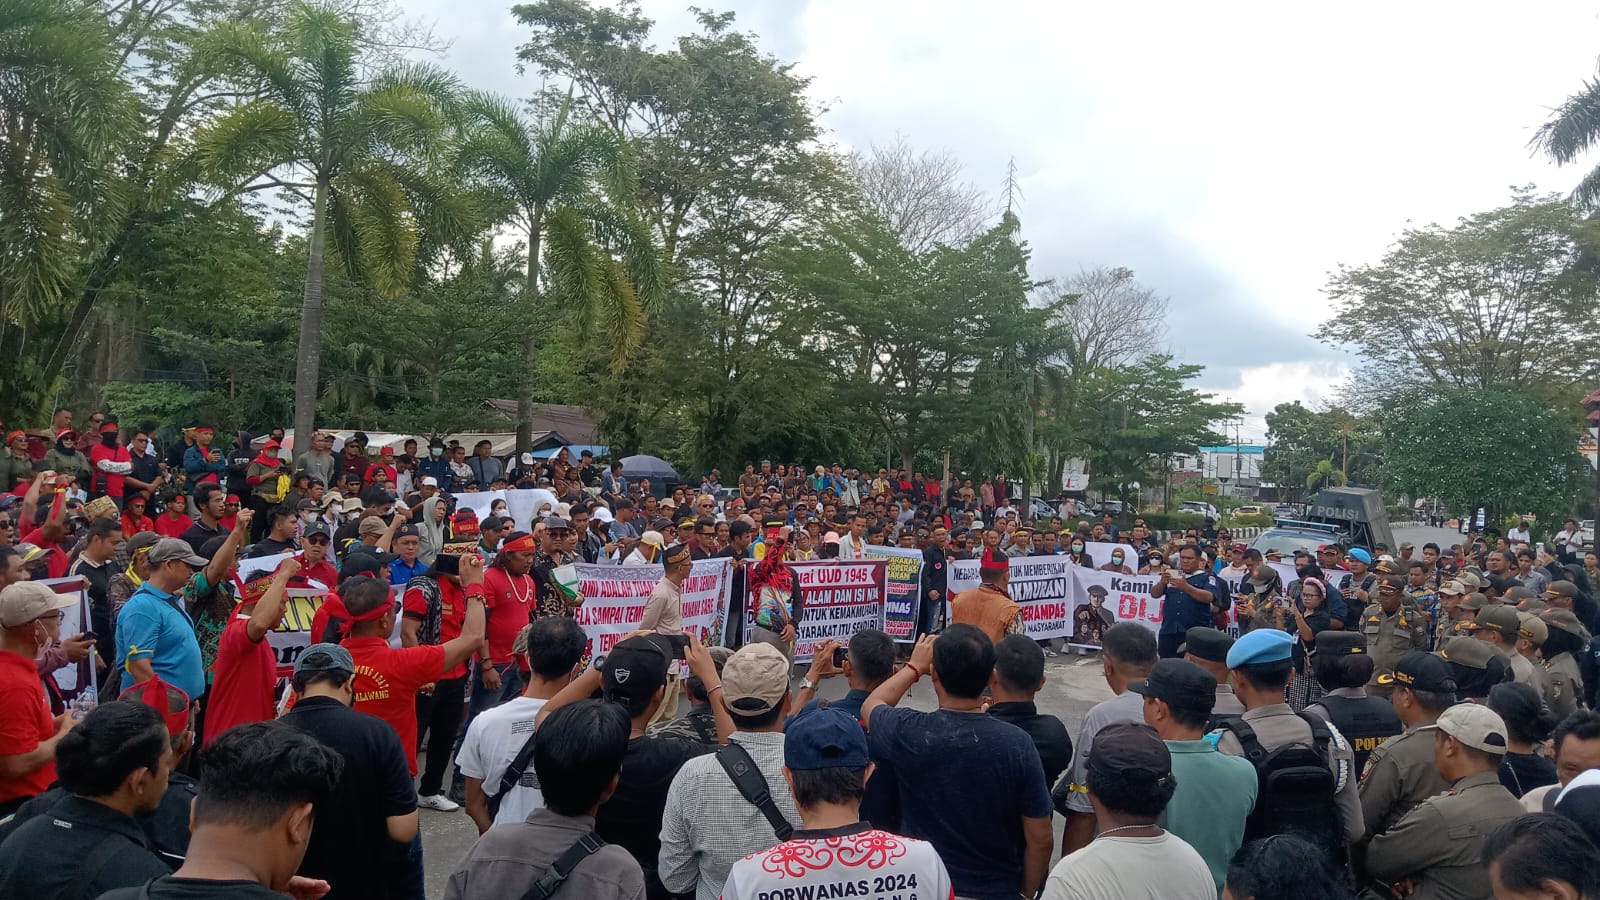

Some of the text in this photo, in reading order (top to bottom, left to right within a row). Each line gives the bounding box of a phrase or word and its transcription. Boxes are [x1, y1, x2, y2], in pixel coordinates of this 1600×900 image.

[1317, 506, 1360, 520] POLISI
[817, 568, 842, 584] UUD
[845, 567, 868, 582] 1945
[953, 567, 980, 580] NEGARA
[1023, 562, 1065, 577] MEMBERIKAN
[580, 580, 599, 598] AMI
[600, 580, 633, 598] ADALAH
[1110, 577, 1153, 594] Kami
[805, 589, 832, 606] ALAM
[834, 587, 852, 604] DAN
[855, 586, 865, 602] ISI
[592, 606, 625, 625] SAMPAI
[829, 603, 878, 620] KEMAKMURAN
[839, 622, 852, 636] ITU
[1027, 620, 1066, 633] MASYARAKAT
[353, 690, 389, 702] ALAWANG
[759, 873, 918, 900] PORWANAS 2024
